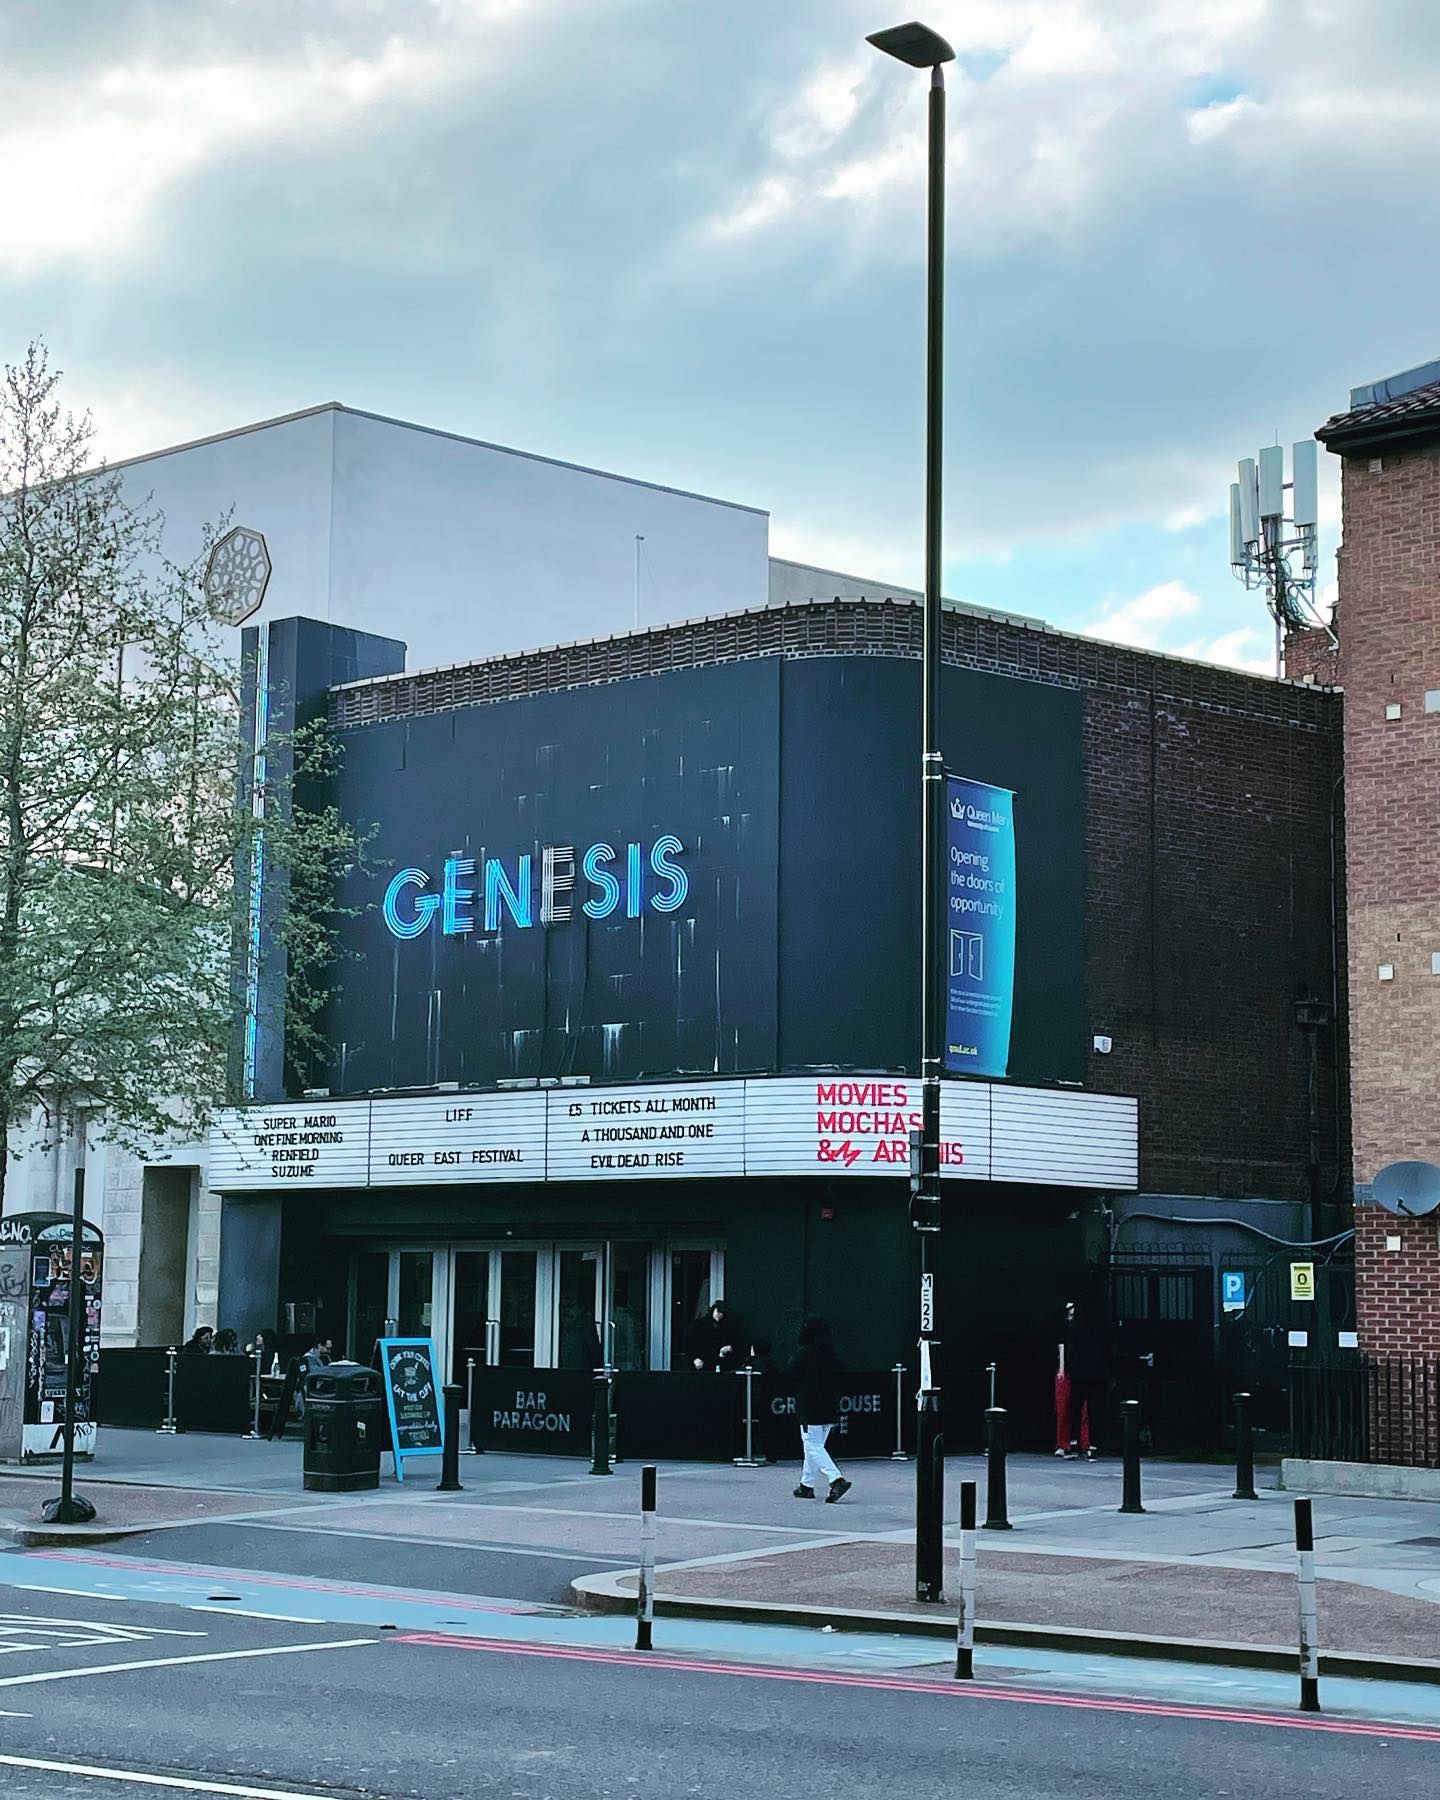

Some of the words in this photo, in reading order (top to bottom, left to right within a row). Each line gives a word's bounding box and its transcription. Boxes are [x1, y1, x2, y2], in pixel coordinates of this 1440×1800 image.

[966, 805, 991, 823] Queen
[950, 846, 989, 872] Opening
[383, 834, 689, 940] GENESIS
[950, 869, 965, 887] the
[966, 873, 994, 893] doors
[950, 896, 1005, 921] opportunity
[816, 1083, 908, 1107] MOVIES
[445, 1108, 473, 1122] LIFF
[568, 1103, 582, 1117] £5
[591, 1100, 641, 1115] TICKETS
[645, 1098, 668, 1112] ALL
[672, 1096, 716, 1111] MONTH
[263, 1117, 296, 1130] SUPER
[304, 1115, 336, 1128] MARIO
[816, 1111, 926, 1135] MOCHAS
[254, 1134, 275, 1146] ONE
[276, 1132, 298, 1145] FINE
[299, 1131, 343, 1144] MORNING
[581, 1129, 590, 1142] A
[594, 1127, 657, 1142] THOUSAND
[659, 1125, 685, 1140] AND
[688, 1124, 714, 1138] ONE
[271, 1148, 319, 1161] RENFIELD
[388, 1152, 424, 1166] QUEER
[434, 1151, 462, 1165] EAST
[472, 1149, 523, 1163] FESTIVAL
[590, 1154, 616, 1168] EVIL
[617, 1153, 649, 1168] DEAD
[655, 1152, 684, 1166] RISE
[271, 1164, 315, 1178] SUZUME
[1226, 1275, 1241, 1298] P
[516, 1391, 546, 1410] BAR
[493, 1410, 570, 1432] PARAGON
